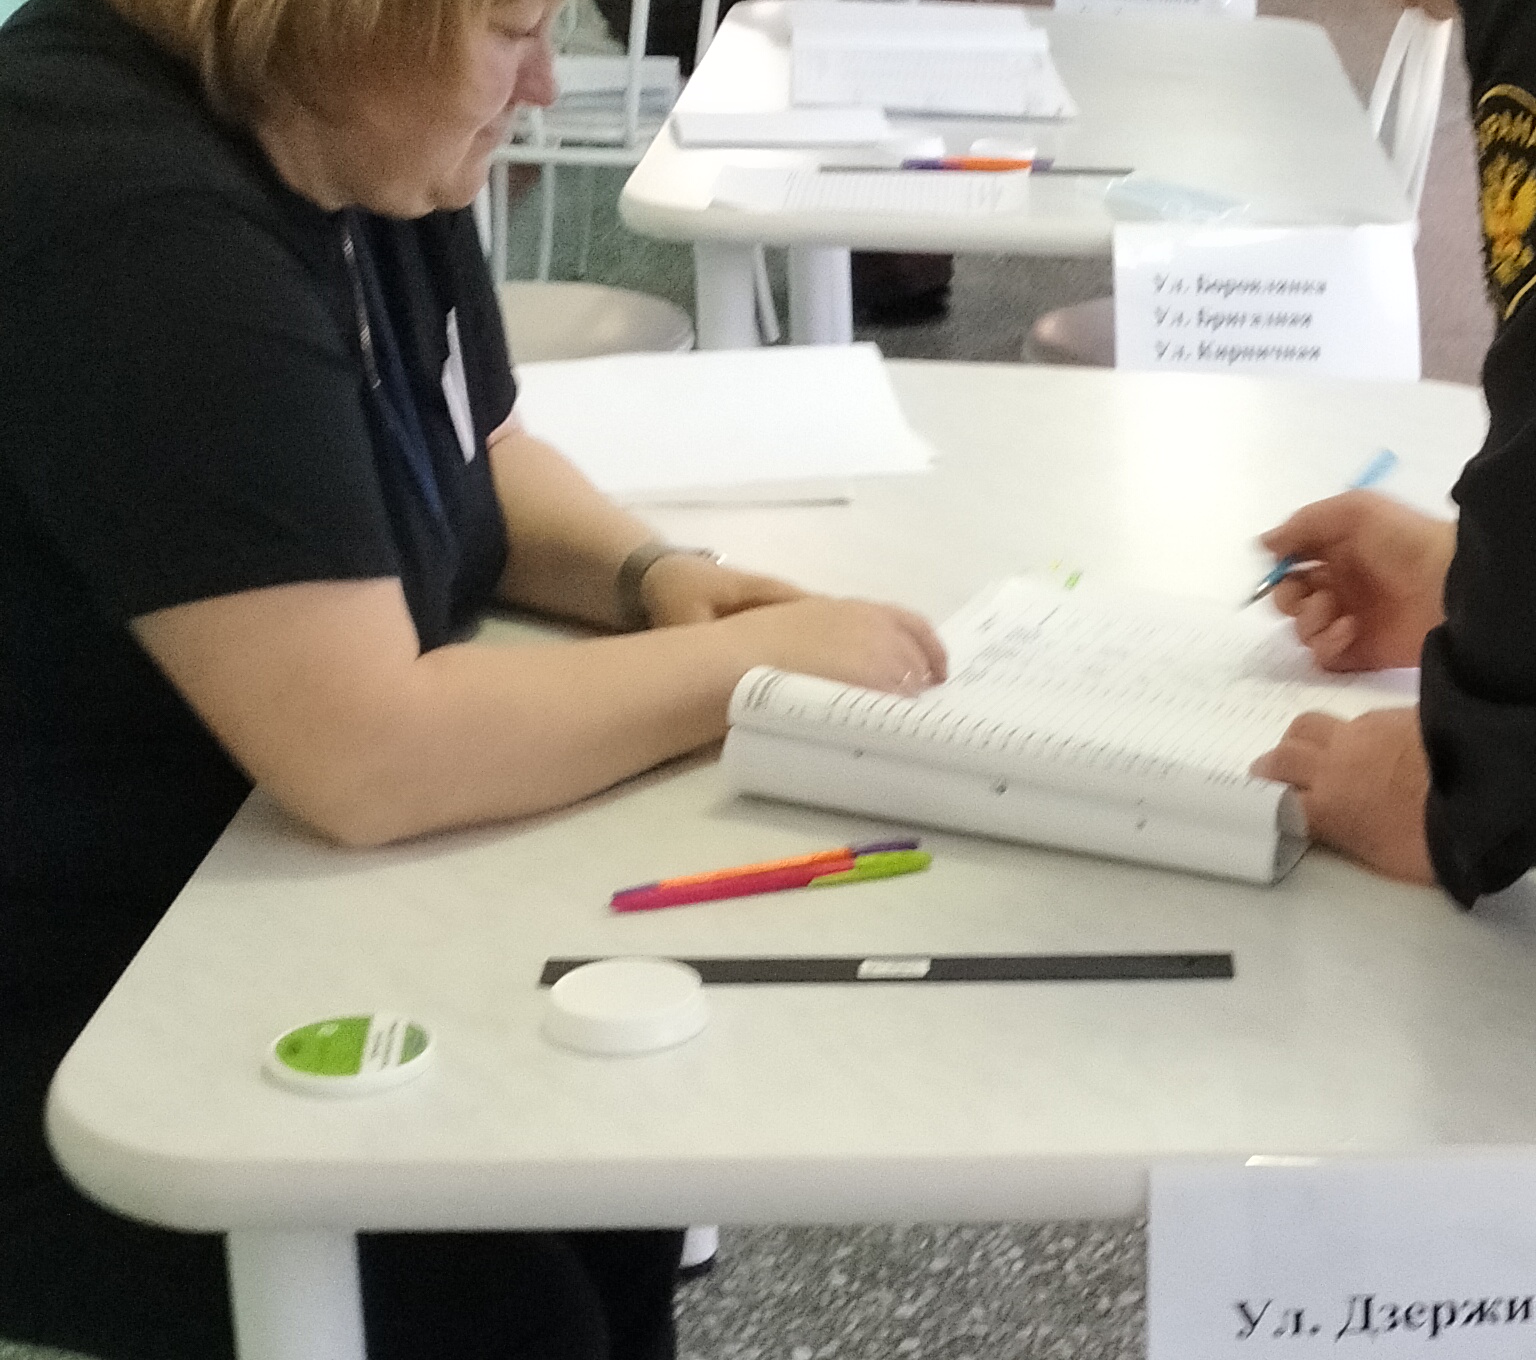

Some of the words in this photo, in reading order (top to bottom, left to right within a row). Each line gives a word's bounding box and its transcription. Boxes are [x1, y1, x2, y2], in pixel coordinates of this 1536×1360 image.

[1154, 272, 1191, 295] Ул.
[1154, 306, 1192, 328] Ул.
[1155, 340, 1192, 362] Ул.
[1233, 1296, 1322, 1341] Ул.
